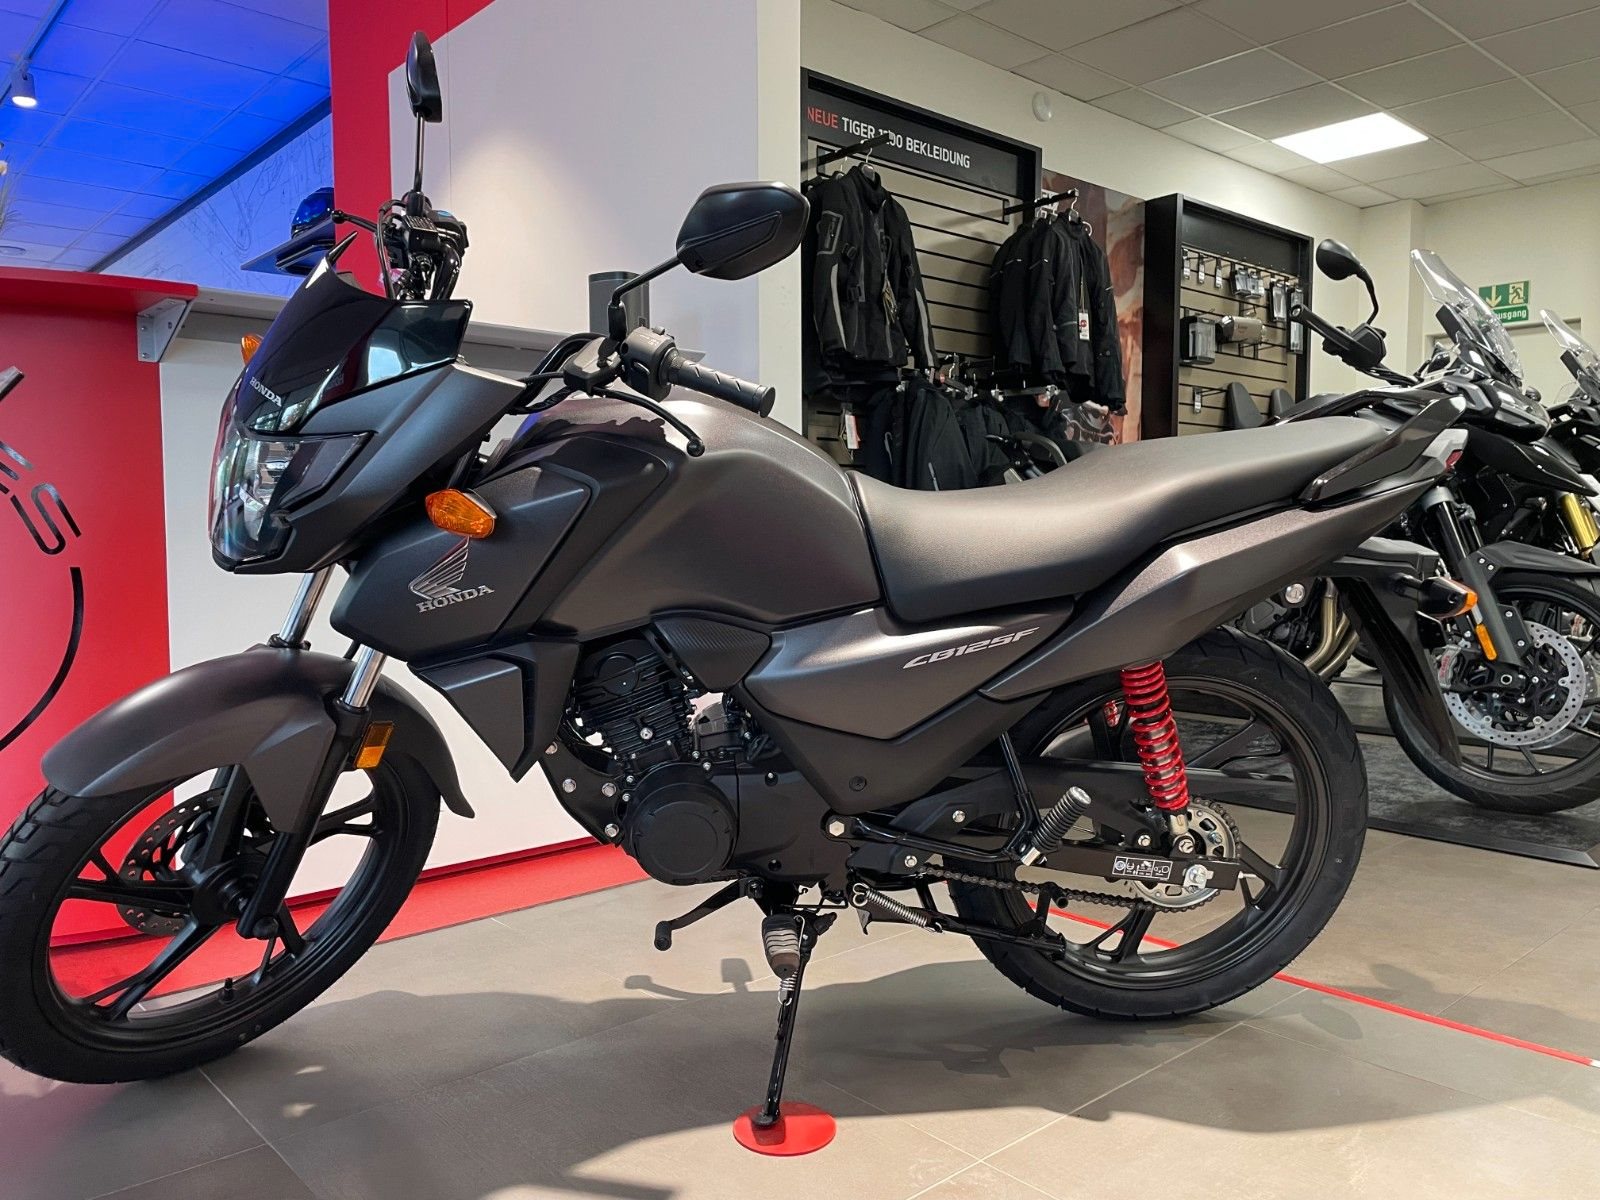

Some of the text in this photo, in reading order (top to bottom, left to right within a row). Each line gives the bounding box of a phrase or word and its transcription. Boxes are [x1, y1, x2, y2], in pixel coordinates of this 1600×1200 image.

[807, 106, 839, 129] NEUE
[841, 117, 875, 139] TIGER
[906, 137, 970, 168] BEKLEIDUNG
[249, 376, 282, 407] HONDA
[415, 585, 495, 612] HONDA
[902, 626, 1041, 669] CB125F
